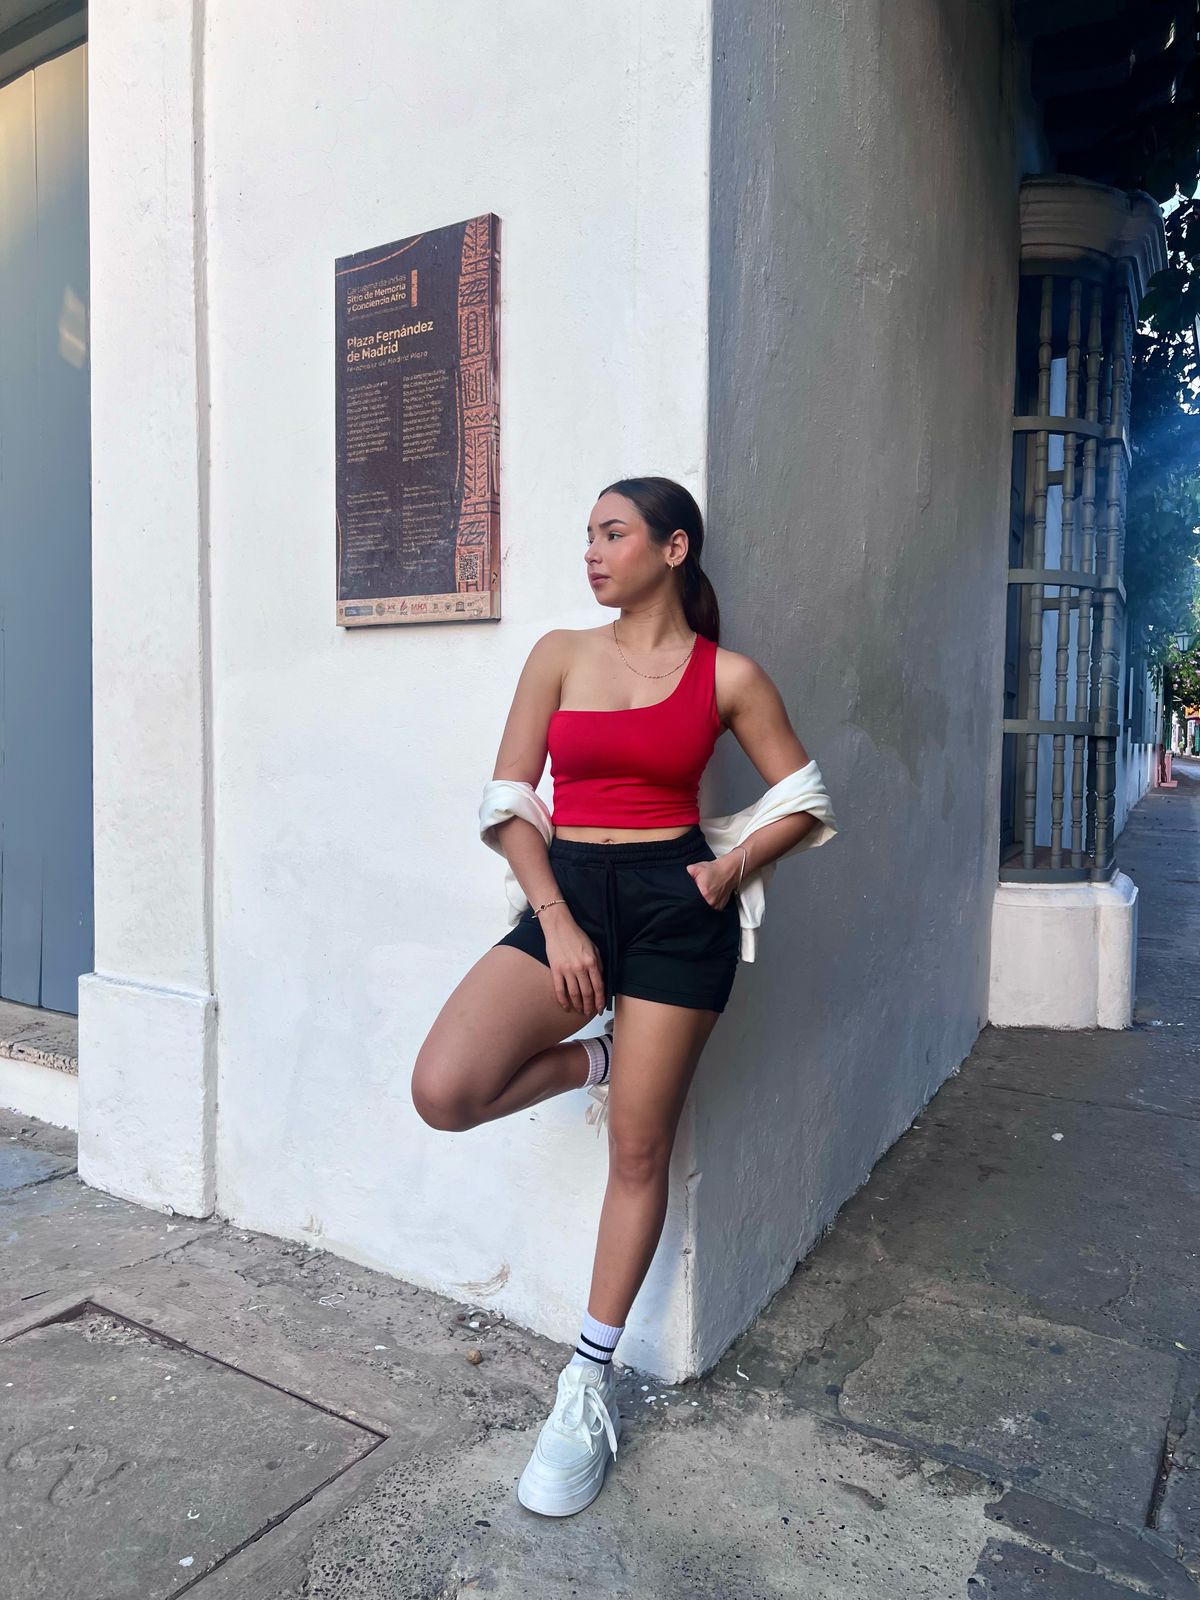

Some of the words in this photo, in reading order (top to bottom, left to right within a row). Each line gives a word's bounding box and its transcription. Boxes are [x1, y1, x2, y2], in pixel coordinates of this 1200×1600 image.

[346, 307, 351, 315] y
[352, 296, 390, 312] Conciencia
[391, 292, 407, 303] Afro
[347, 294, 364, 305] Sitio
[364, 291, 374, 300] de
[375, 283, 406, 297] Memoria
[347, 335, 375, 349] Plaza
[376, 320, 434, 343] Fernández
[347, 350, 360, 363] de
[362, 341, 399, 360] Madrid
